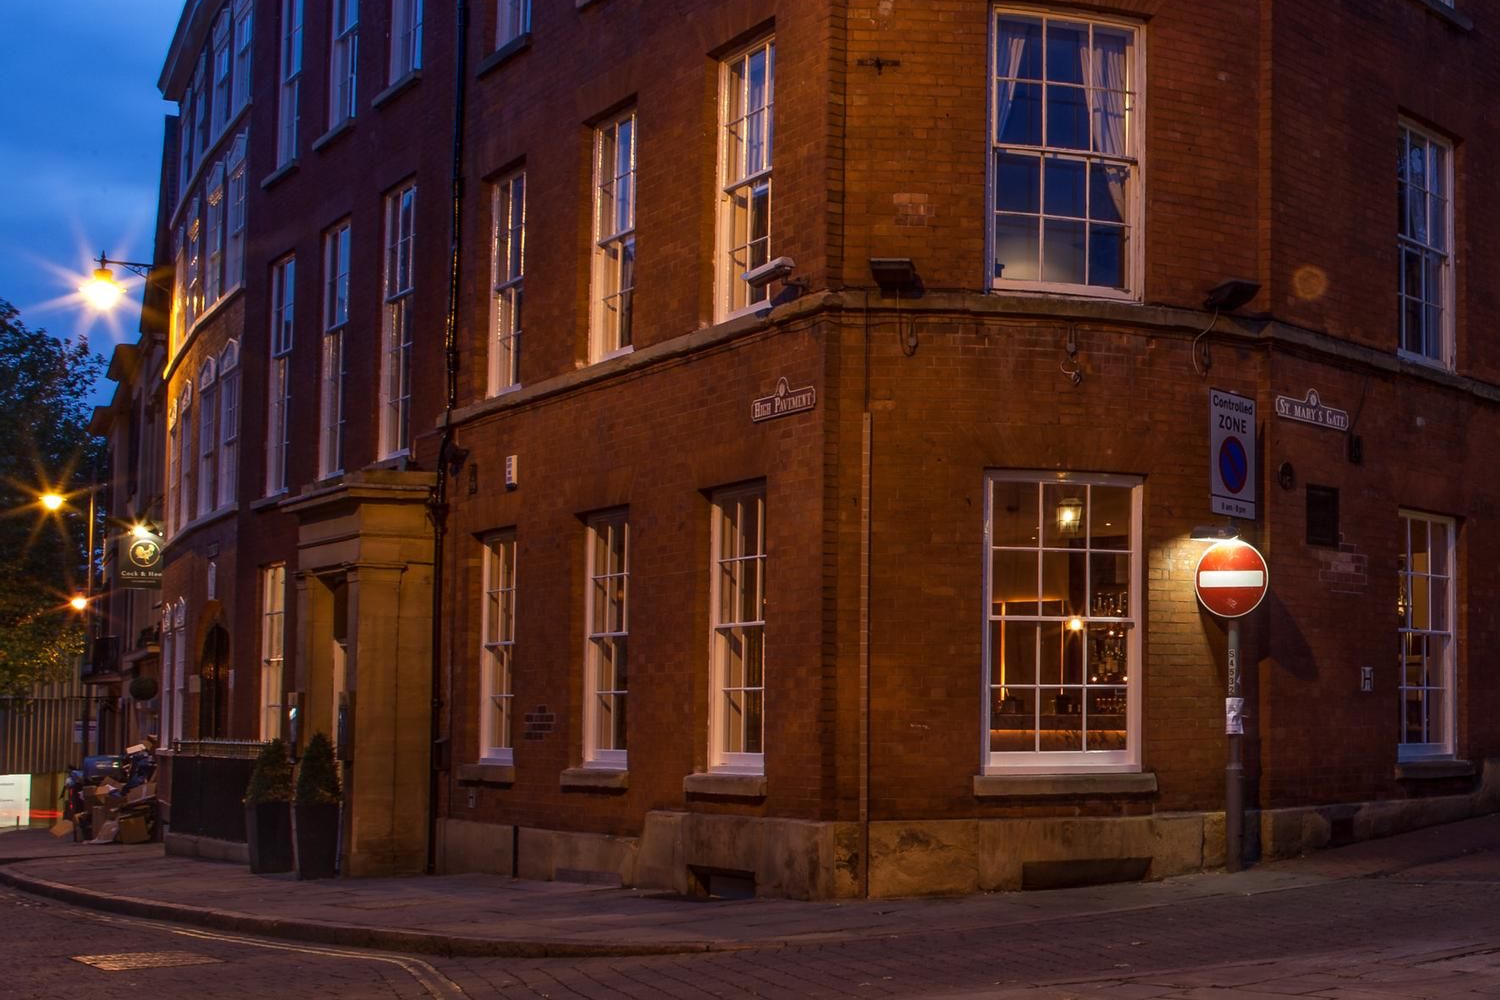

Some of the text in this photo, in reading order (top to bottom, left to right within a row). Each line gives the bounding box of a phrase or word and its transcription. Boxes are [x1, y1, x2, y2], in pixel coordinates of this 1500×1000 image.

[754, 392, 812, 418] HIGH PAVEMENT
[1213, 394, 1253, 416] Controlled
[1218, 414, 1247, 434] ZONE
[1326, 410, 1346, 427] GATE
